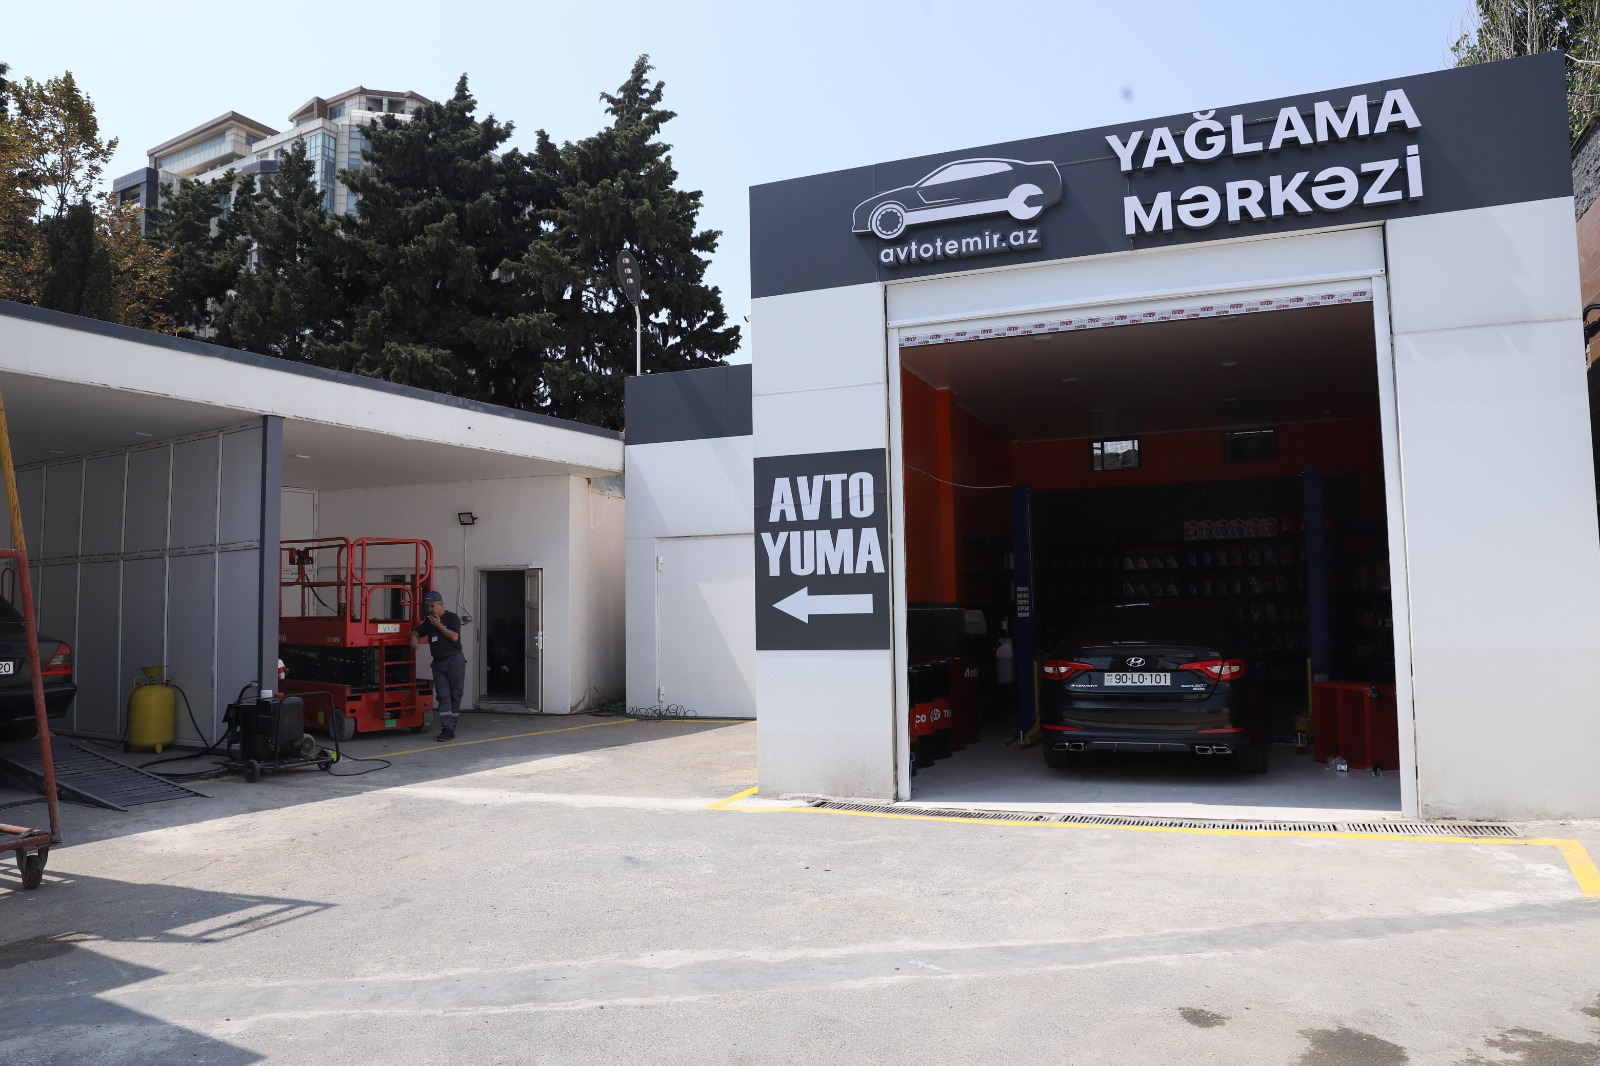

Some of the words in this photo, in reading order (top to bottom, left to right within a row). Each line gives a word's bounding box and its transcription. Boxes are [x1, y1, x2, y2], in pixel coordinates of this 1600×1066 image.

[1105, 88, 1422, 173] YAĞLAMA
[1123, 144, 1424, 236] MƏRKƏZİ
[880, 228, 1039, 263] avtotemir.az
[768, 471, 875, 523] AVTO
[760, 527, 886, 577] YUMA
